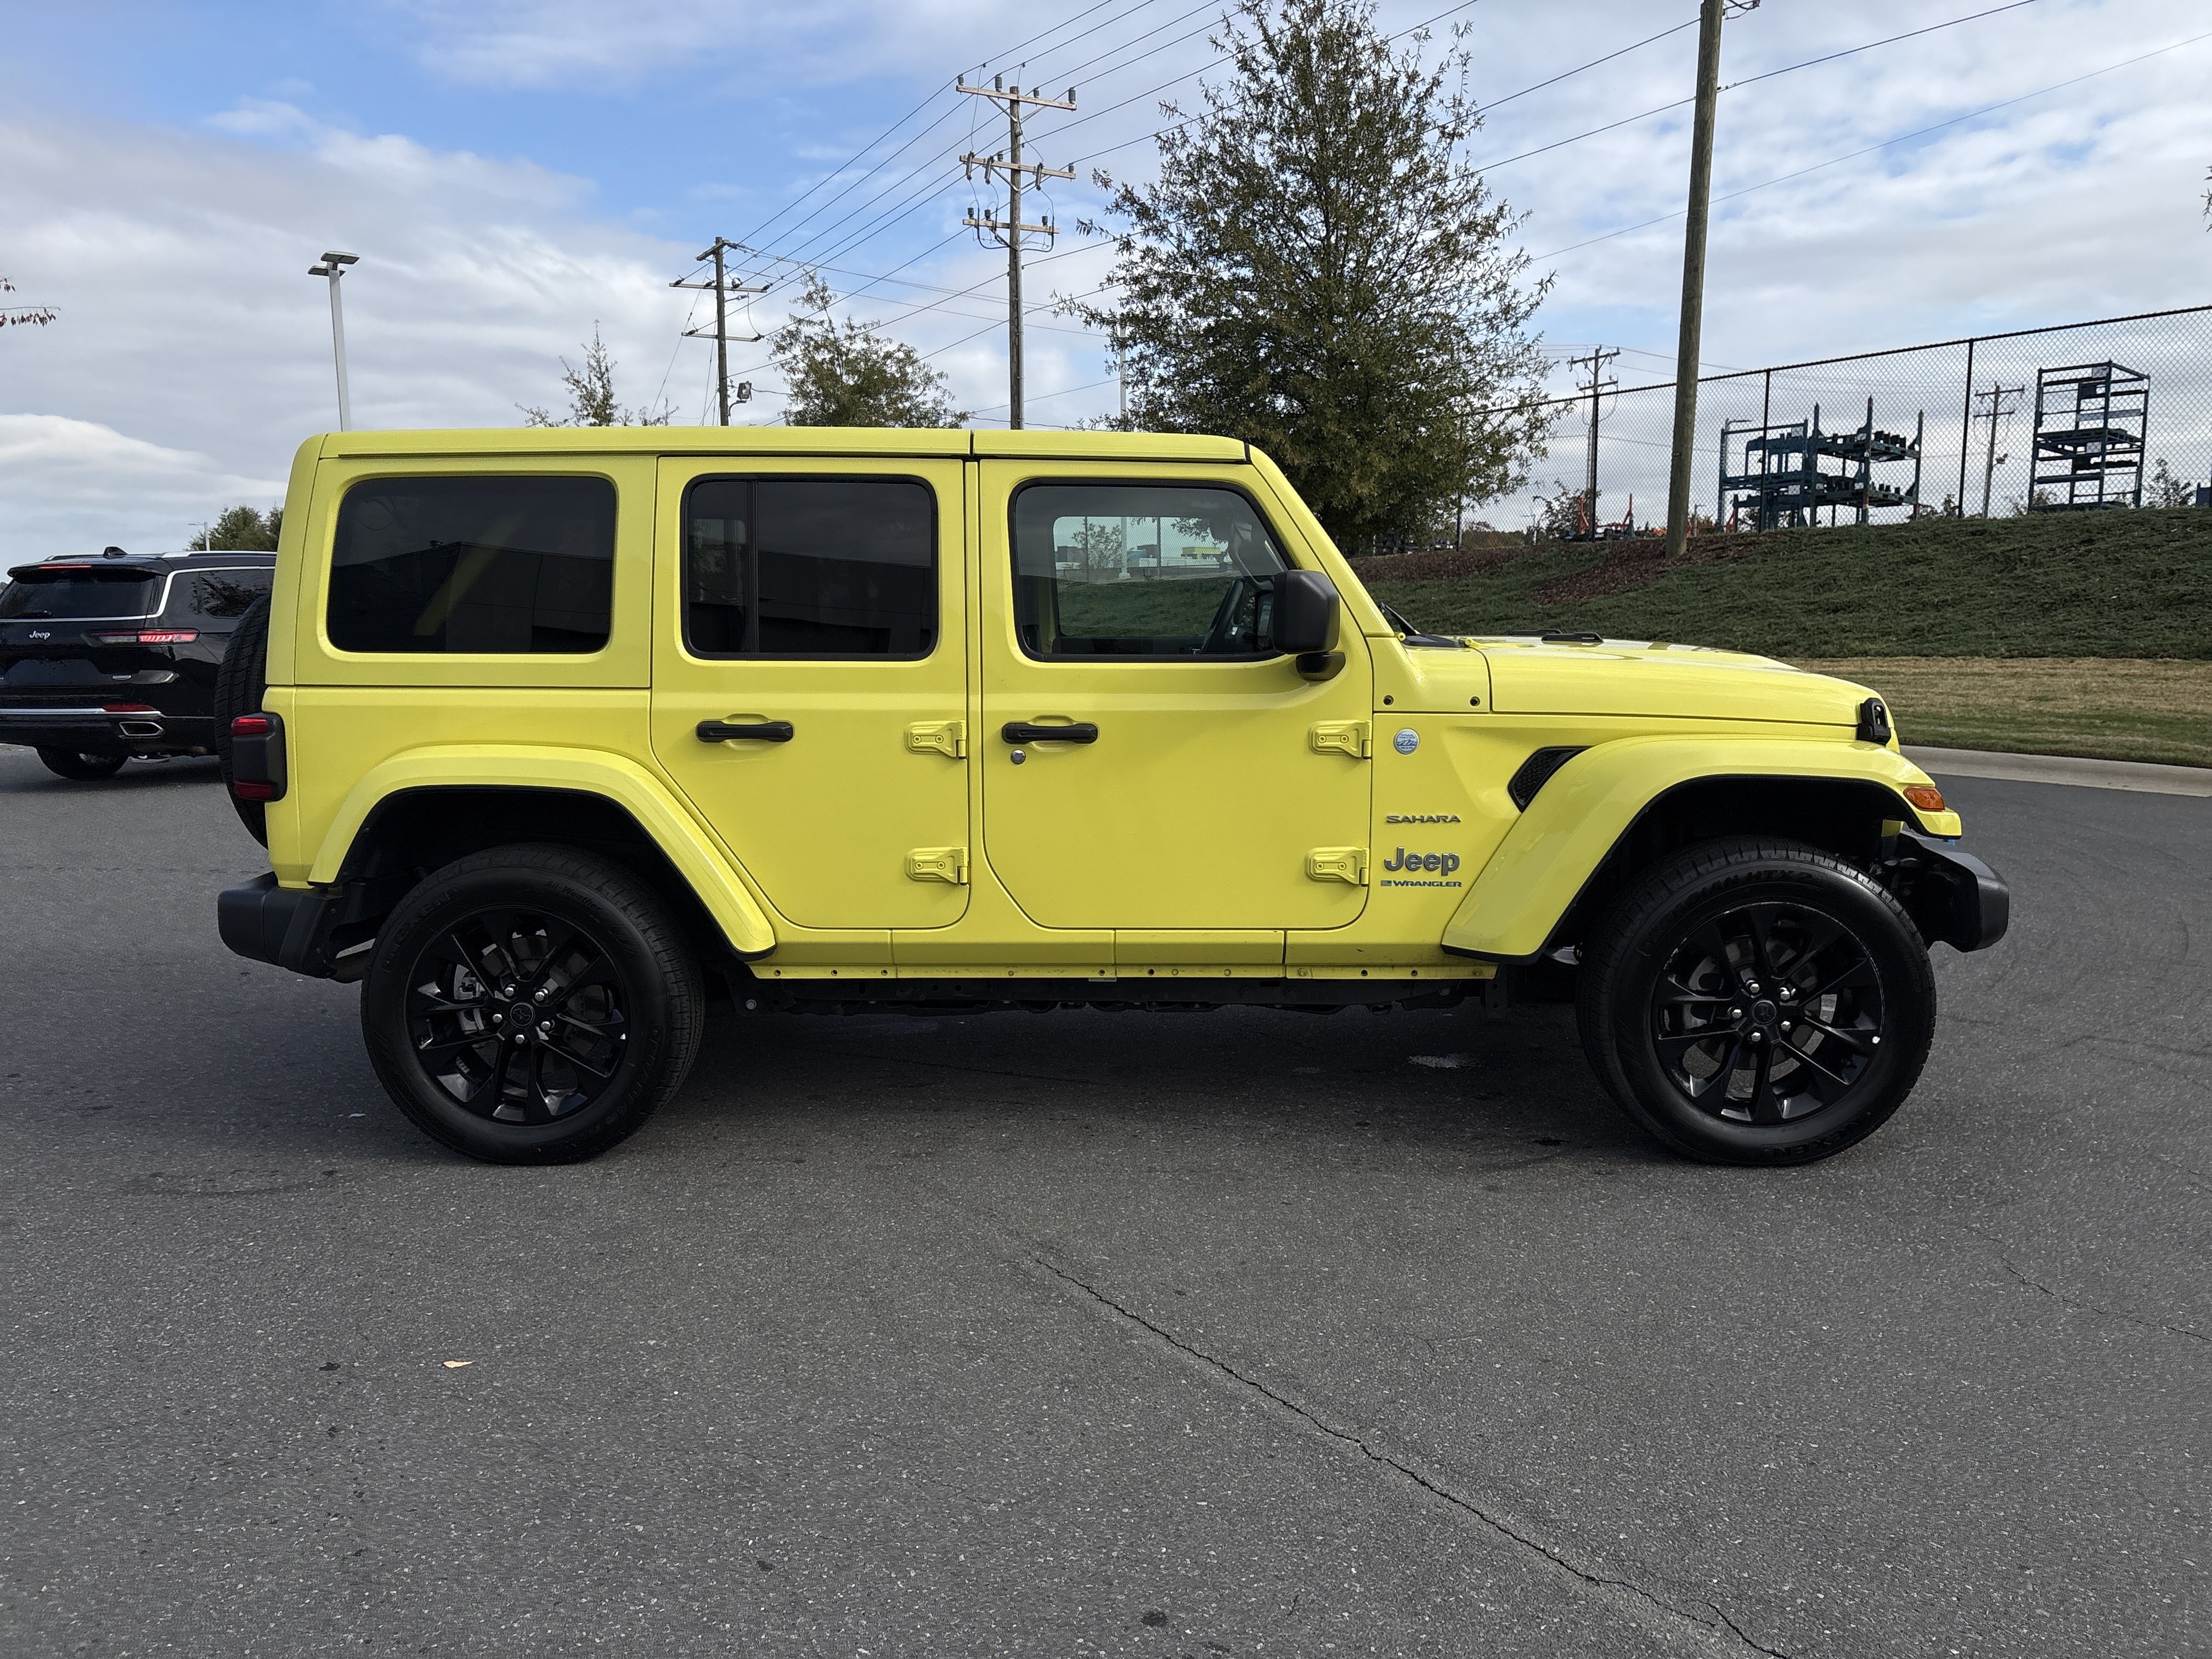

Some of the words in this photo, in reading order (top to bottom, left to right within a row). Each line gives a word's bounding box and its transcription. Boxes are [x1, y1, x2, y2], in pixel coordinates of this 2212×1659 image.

[29, 630, 50, 640] Jeep
[1386, 815, 1462, 823] SAHARA
[1384, 847, 1460, 876] Jeep
[544, 881, 602, 911] All-Weather
